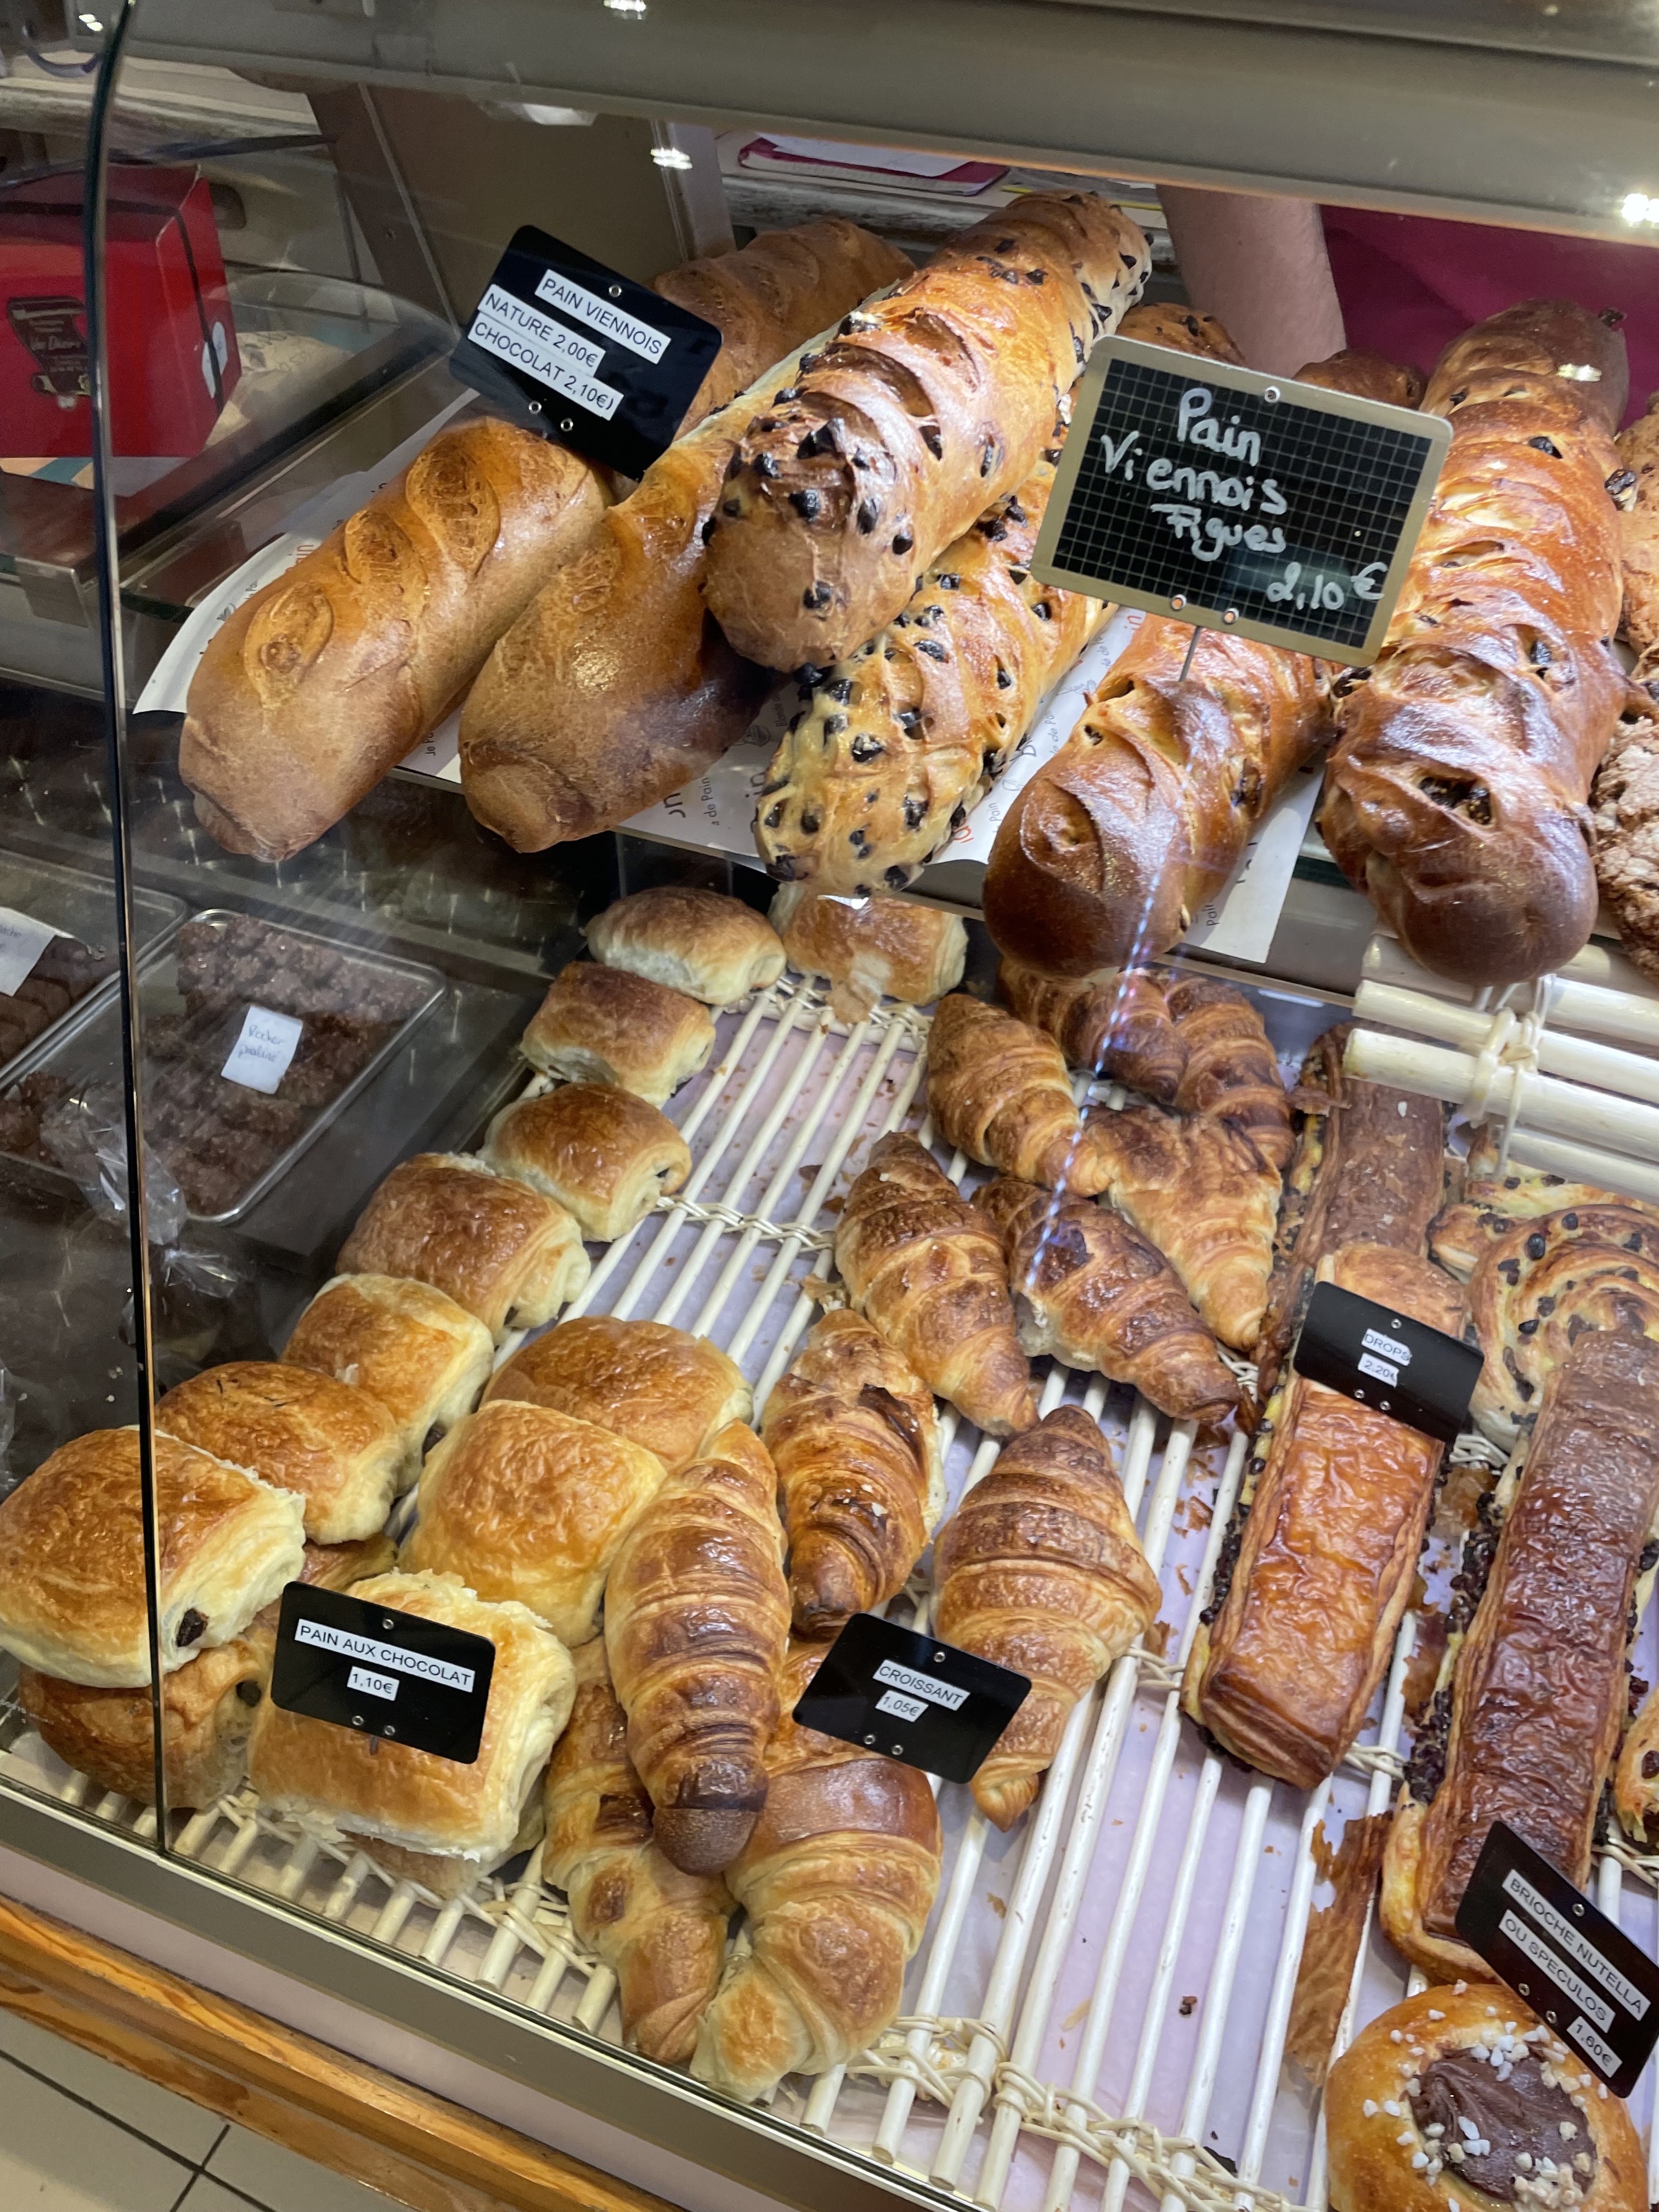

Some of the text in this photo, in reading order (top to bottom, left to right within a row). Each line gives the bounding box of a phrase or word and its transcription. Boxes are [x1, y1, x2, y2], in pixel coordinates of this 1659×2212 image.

[486, 293, 599, 368] NATURE 2,00€
[543, 278, 662, 354] PAIN VIENNOIS
[475, 321, 614, 411] CHOCOLAT 2,10€)
[1177, 387, 1261, 466] Pain
[1100, 431, 1288, 515] Viennois
[1364, 1334, 1410, 1361] DROPS
[300, 1625, 472, 1686] PAIN AUX CHOCOLAT
[352, 1673, 393, 1694] 1,10€
[879, 1666, 964, 1705] CROISSANT
[883, 1696, 919, 1717] 1,05€
[1505, 1918, 1607, 2021] OU SPECULOS
[1509, 1878, 1643, 2013] BRIOCHE NUTELLA
